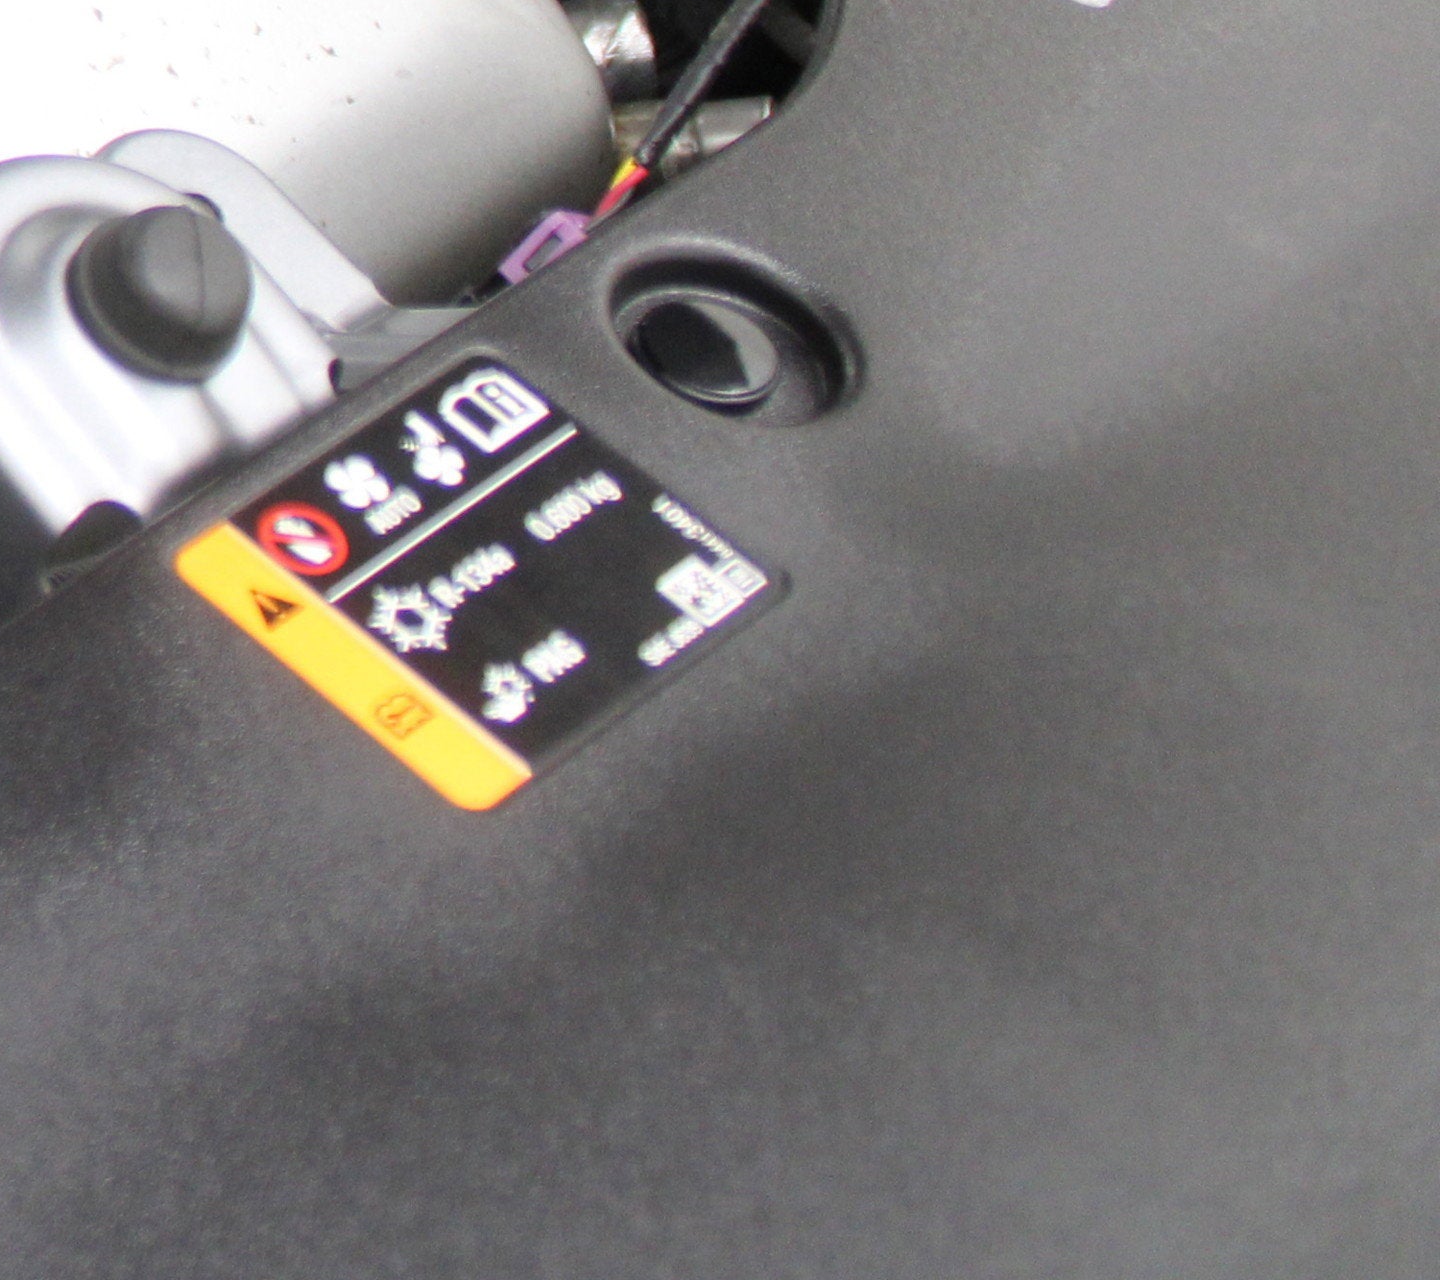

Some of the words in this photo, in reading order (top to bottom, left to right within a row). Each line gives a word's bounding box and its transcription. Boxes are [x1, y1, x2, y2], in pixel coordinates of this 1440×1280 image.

[364, 486, 422, 535] AUTO
[428, 543, 516, 609] R-134a
[524, 487, 592, 541] 0.600
[578, 470, 623, 505] kg
[522, 628, 587, 684] PAG
